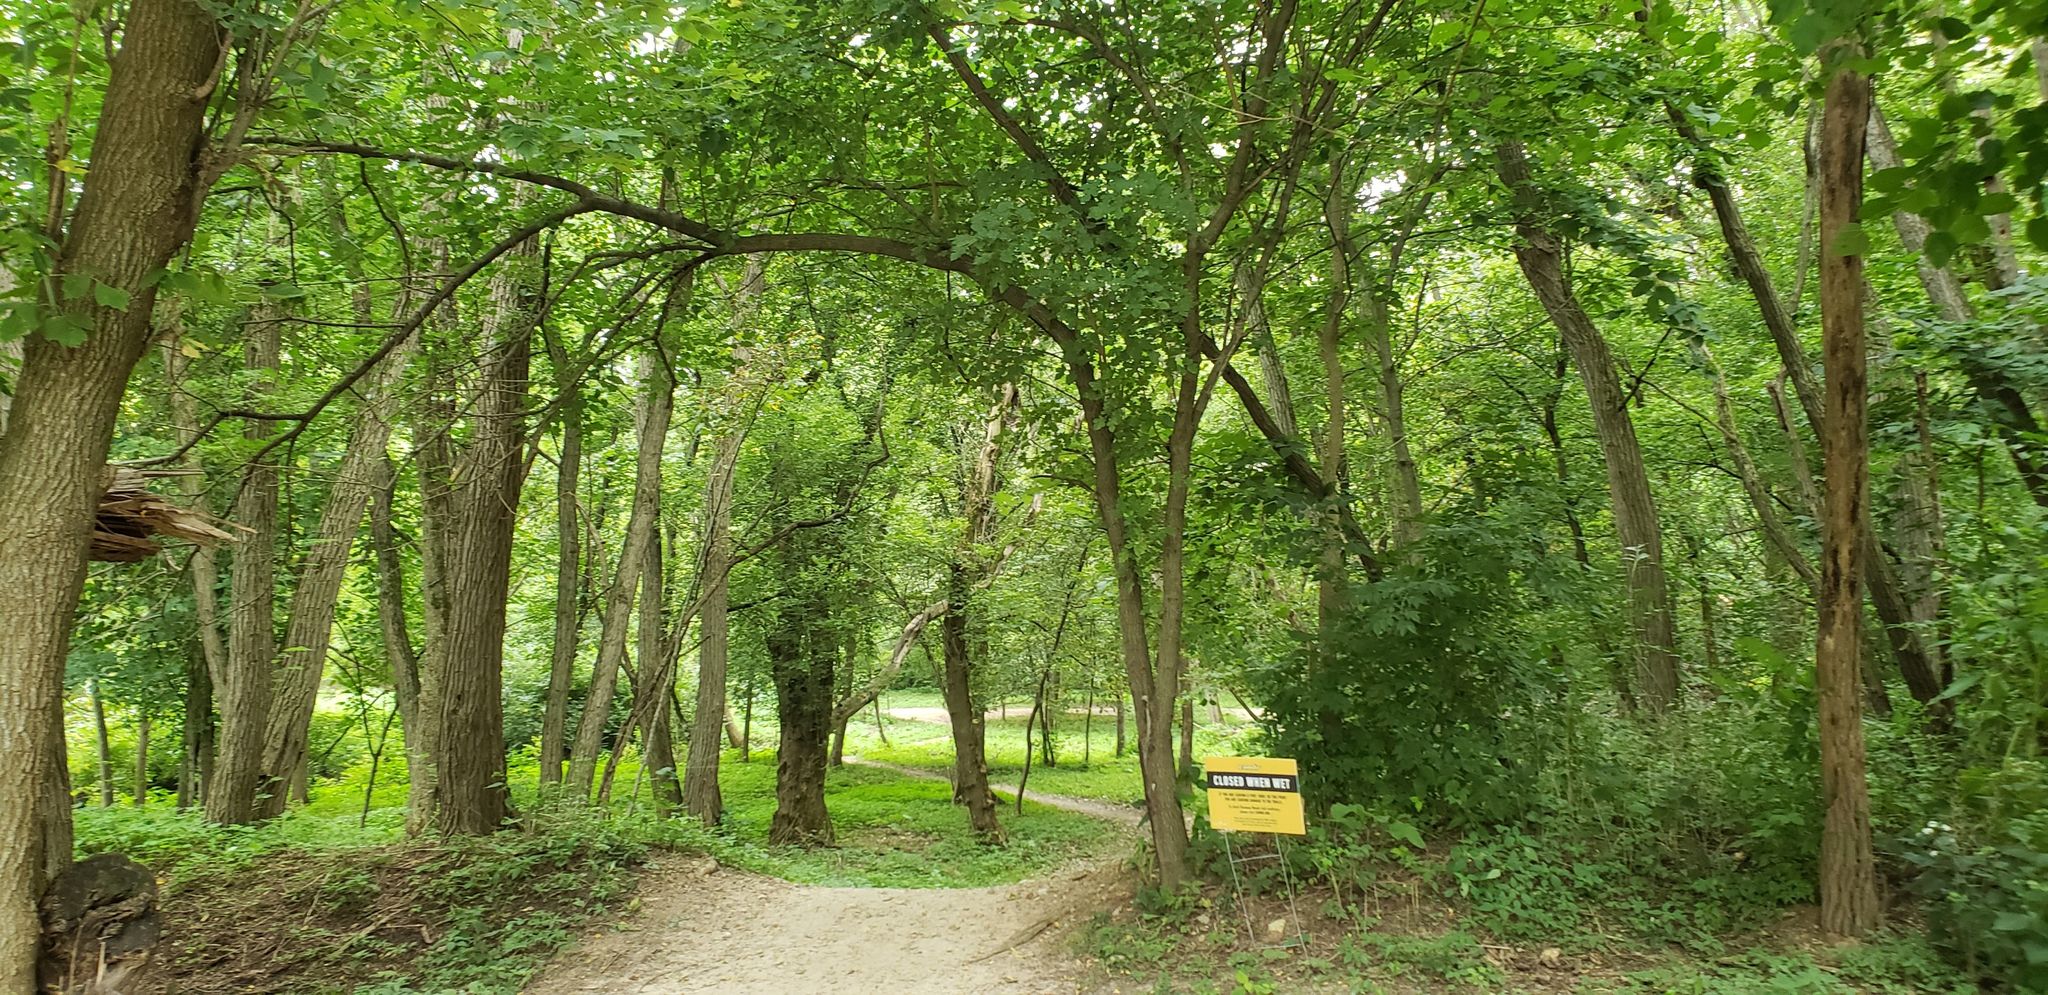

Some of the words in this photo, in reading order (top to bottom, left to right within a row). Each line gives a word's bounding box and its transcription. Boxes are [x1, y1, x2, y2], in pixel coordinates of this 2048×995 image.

[1212, 775, 1245, 787] CLOSED
[1245, 776, 1271, 788] WHEN
[1272, 778, 1291, 789] WET
